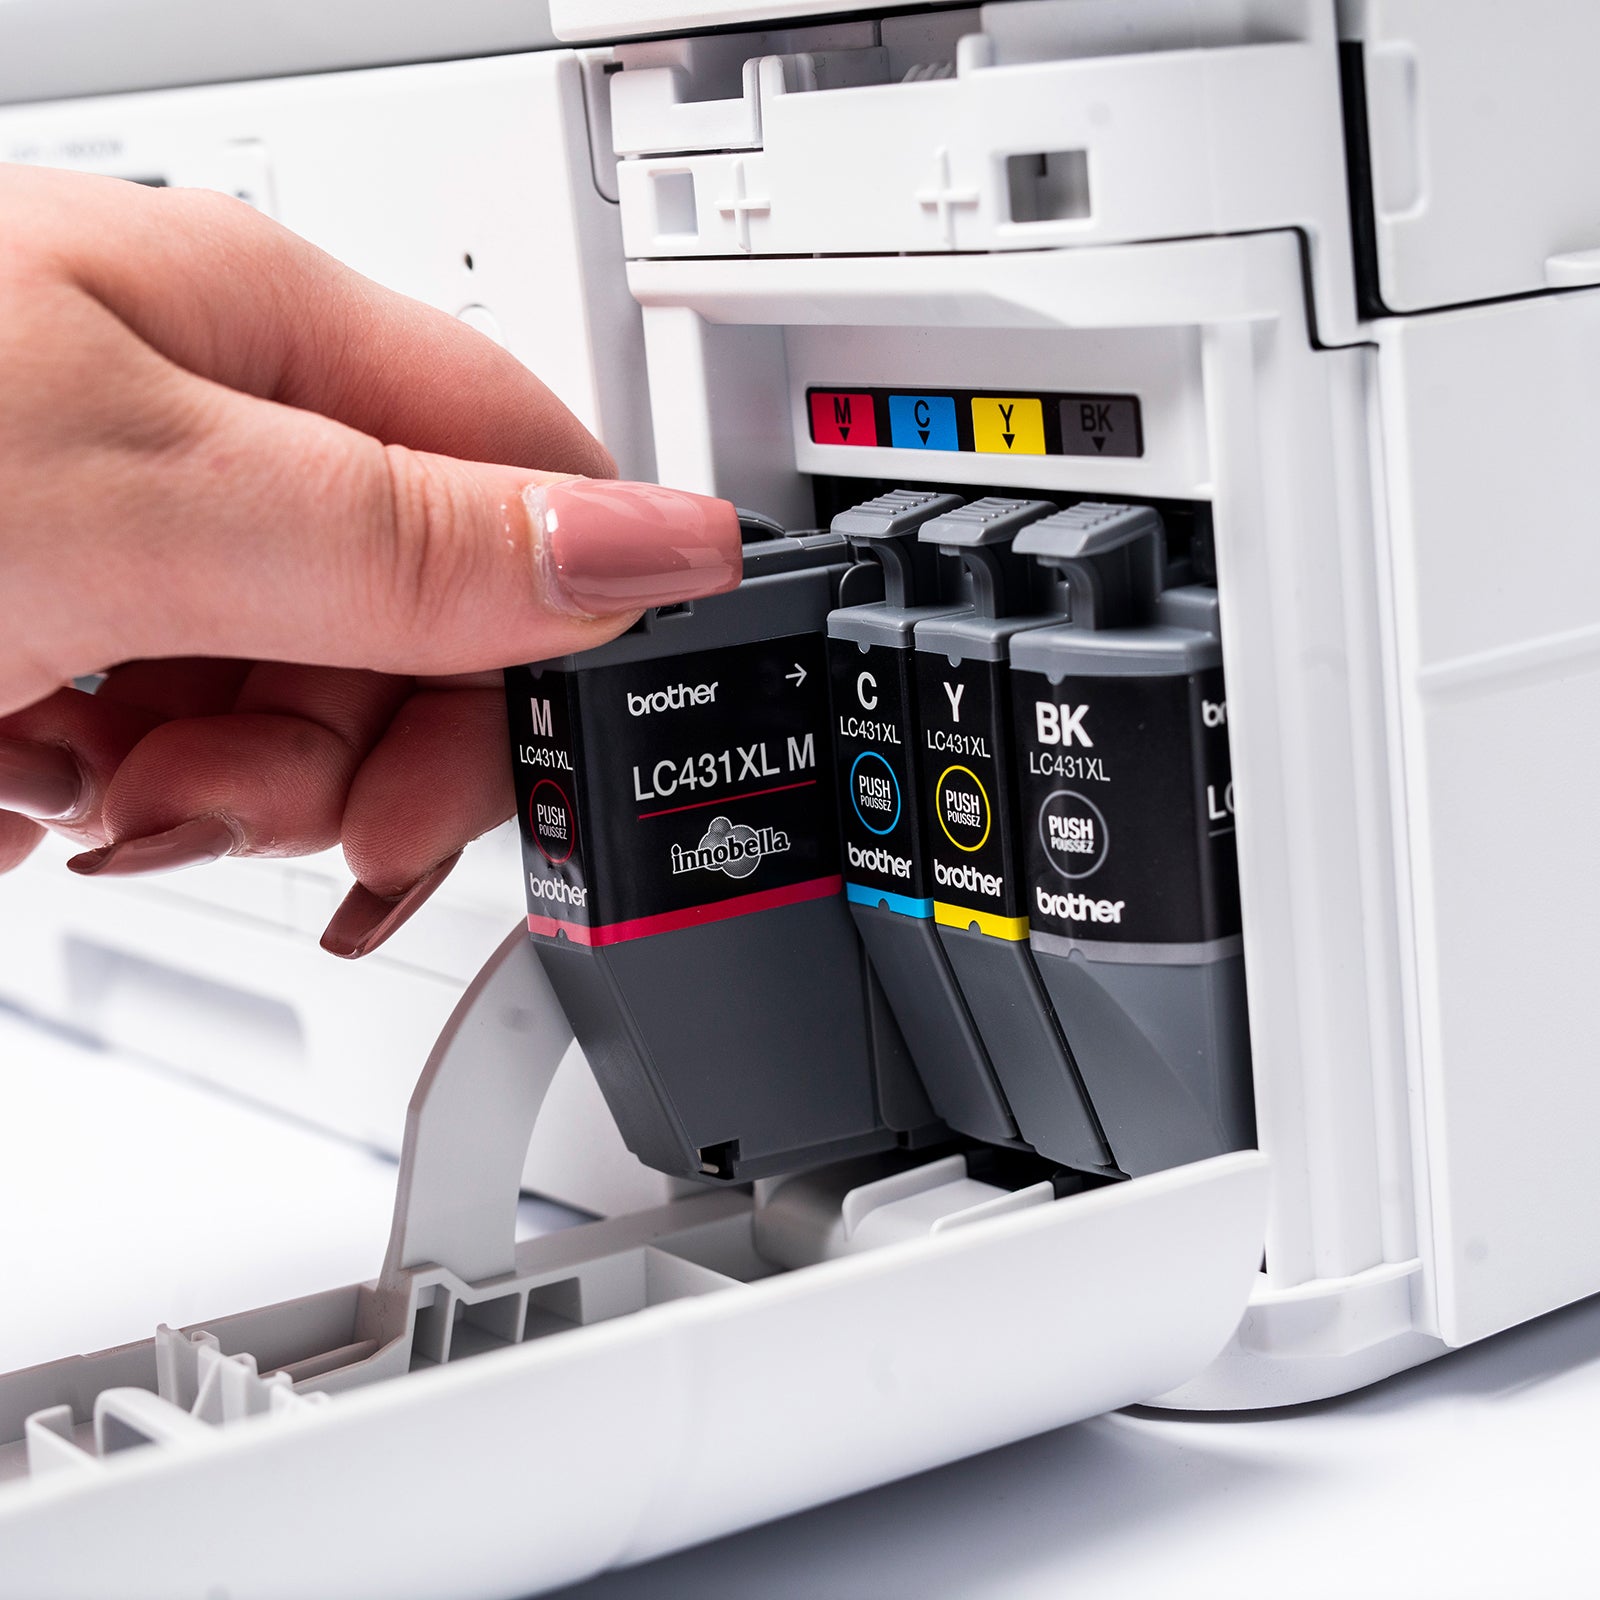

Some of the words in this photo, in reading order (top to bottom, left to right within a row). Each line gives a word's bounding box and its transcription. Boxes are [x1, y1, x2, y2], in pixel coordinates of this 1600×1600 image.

[834, 397, 851, 424] M
[914, 400, 930, 428] C
[998, 404, 1014, 432] Y
[1081, 404, 1113, 432] BK
[627, 682, 718, 716] brother
[857, 671, 877, 710] C
[943, 682, 964, 722] Y
[531, 697, 553, 737] M
[840, 716, 901, 744] LC431XL
[1036, 701, 1093, 747] BK
[519, 744, 573, 770] LC431XL
[927, 730, 990, 758] LC431XL
[633, 742, 779, 801] LC431XL
[787, 733, 816, 771] M
[1030, 752, 1110, 781] LC431XL
[859, 775, 890, 799] PUSH
[537, 803, 566, 827] PUSH
[860, 795, 892, 812] POUSSEZ
[946, 790, 979, 814] PUSH
[539, 824, 567, 839] POUSSEZ
[947, 811, 980, 827] POUSSEZ
[1048, 815, 1094, 839] PUSH
[672, 827, 790, 873] innobella
[1051, 837, 1094, 854] POUSSEZ
[848, 842, 912, 878] brother
[530, 873, 586, 906] brother
[934, 859, 1002, 896] brother
[1036, 887, 1125, 923] brother
